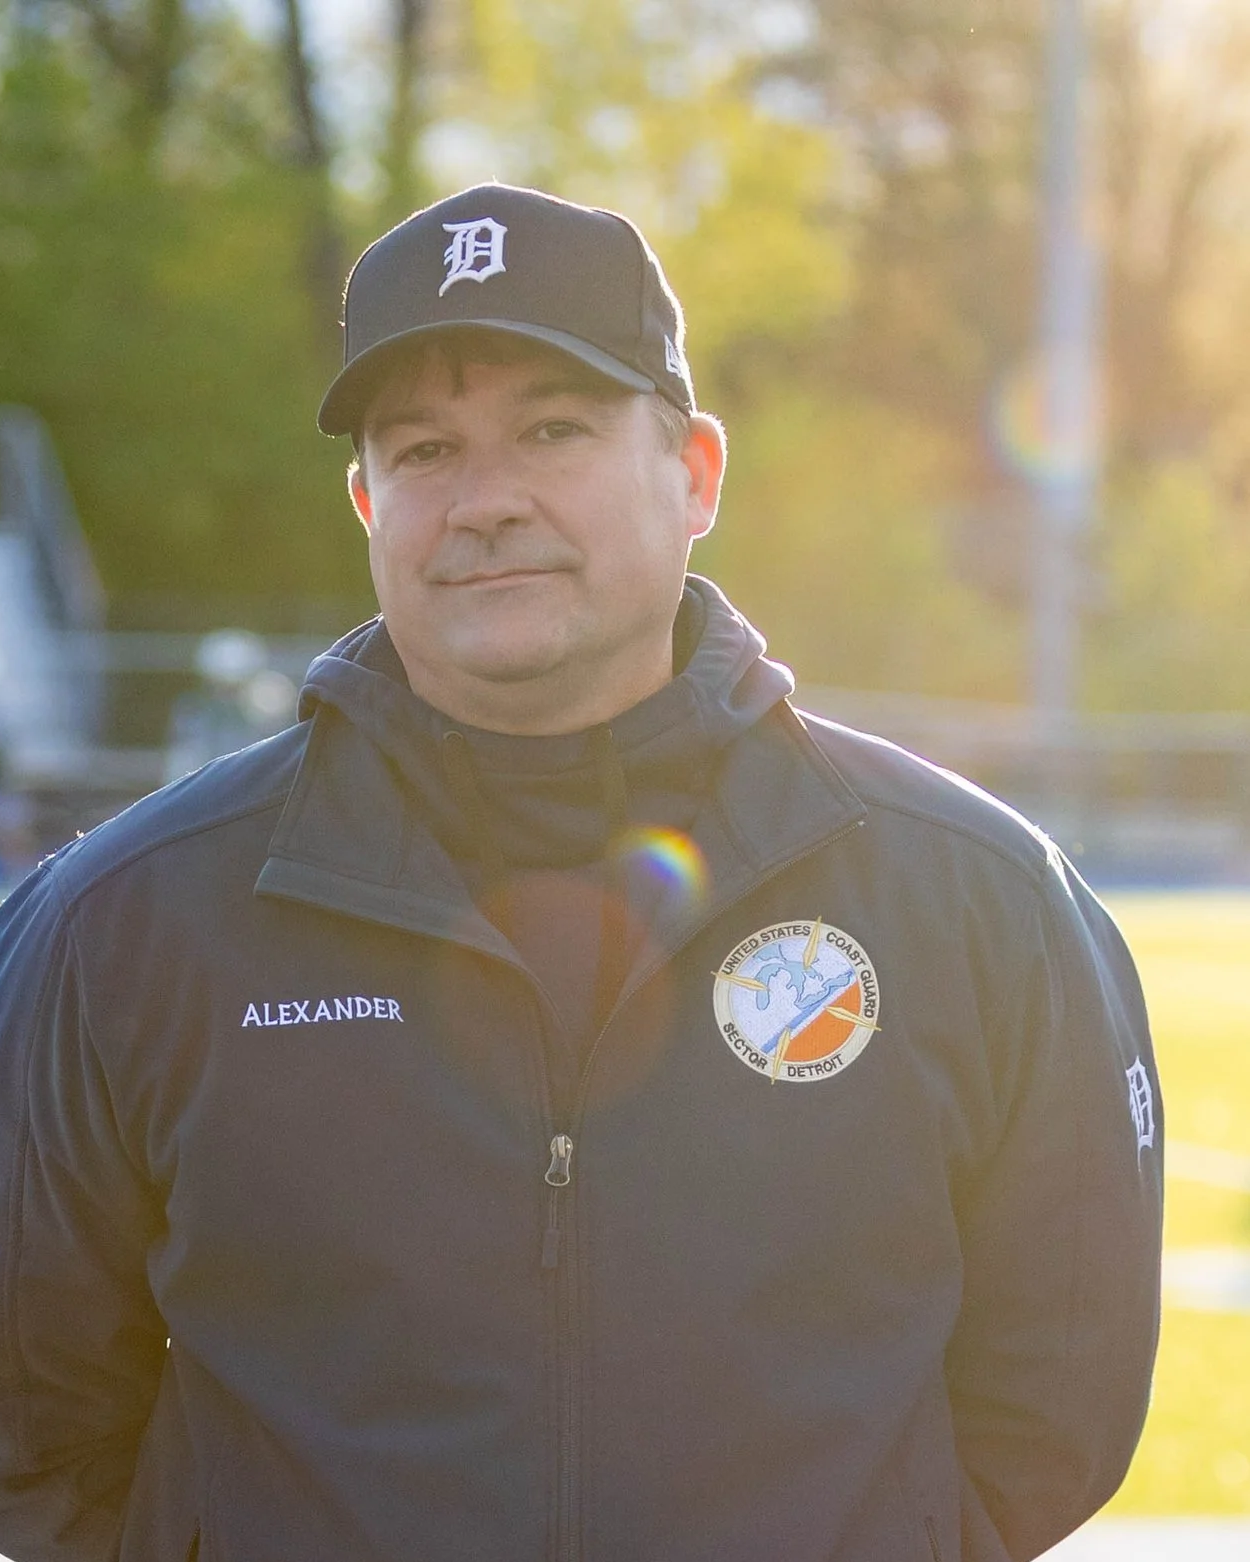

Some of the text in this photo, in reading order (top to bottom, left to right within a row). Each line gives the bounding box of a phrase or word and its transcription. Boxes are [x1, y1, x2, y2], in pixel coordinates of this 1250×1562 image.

[438, 217, 508, 297] D
[722, 925, 875, 1019] UNITED STATES COAST GUARD
[241, 996, 405, 1027] ALEXANDER
[722, 1022, 844, 1078] SECTOR DETROIT
